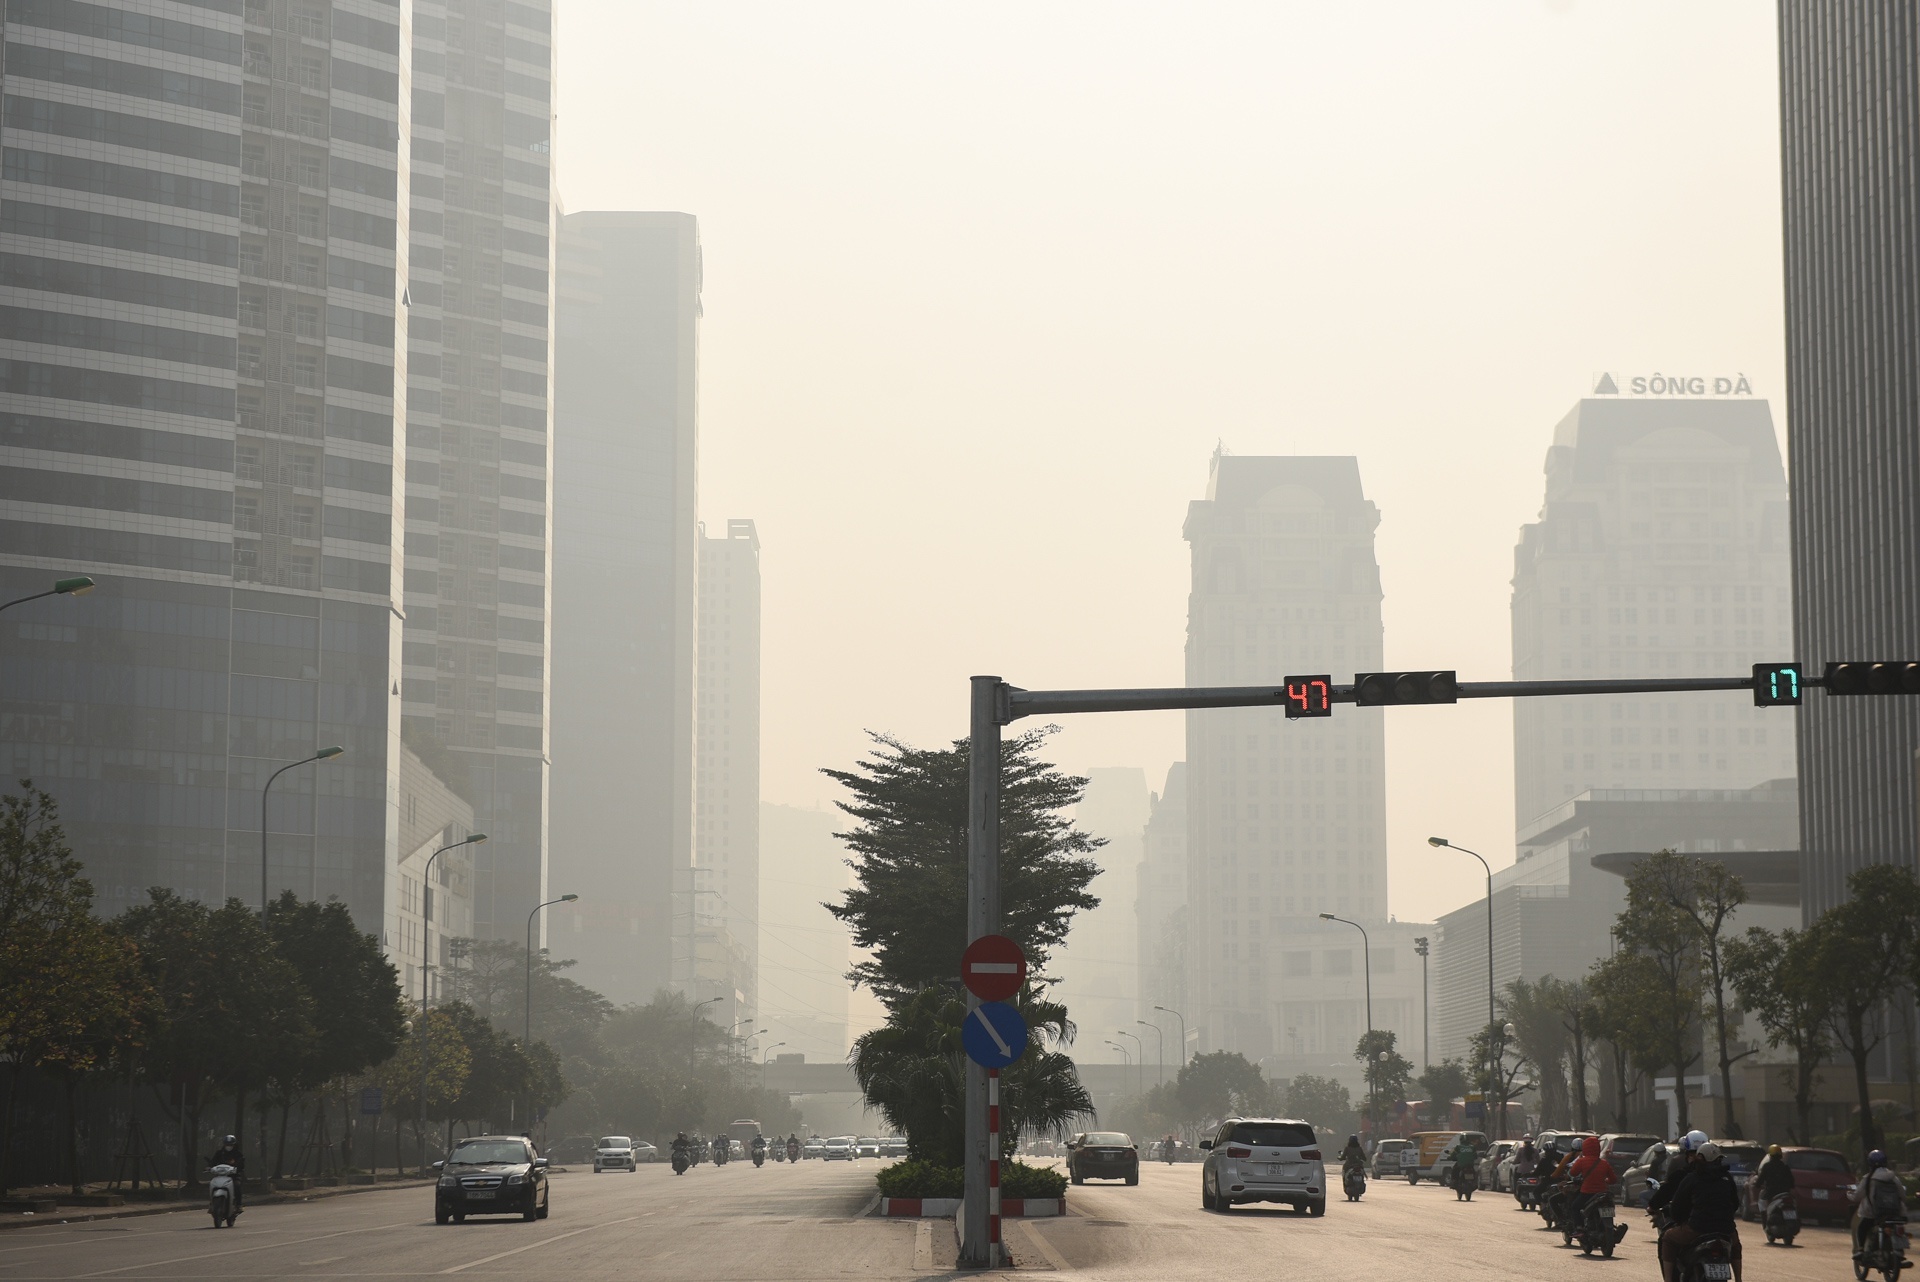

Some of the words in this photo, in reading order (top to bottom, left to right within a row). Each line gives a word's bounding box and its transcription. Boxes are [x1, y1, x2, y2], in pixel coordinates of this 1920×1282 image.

[1631, 372, 1705, 395] SÔNG
[1713, 372, 1752, 395] ĐÀ
[1288, 680, 1327, 710] 47
[1770, 668, 1798, 699] 17
